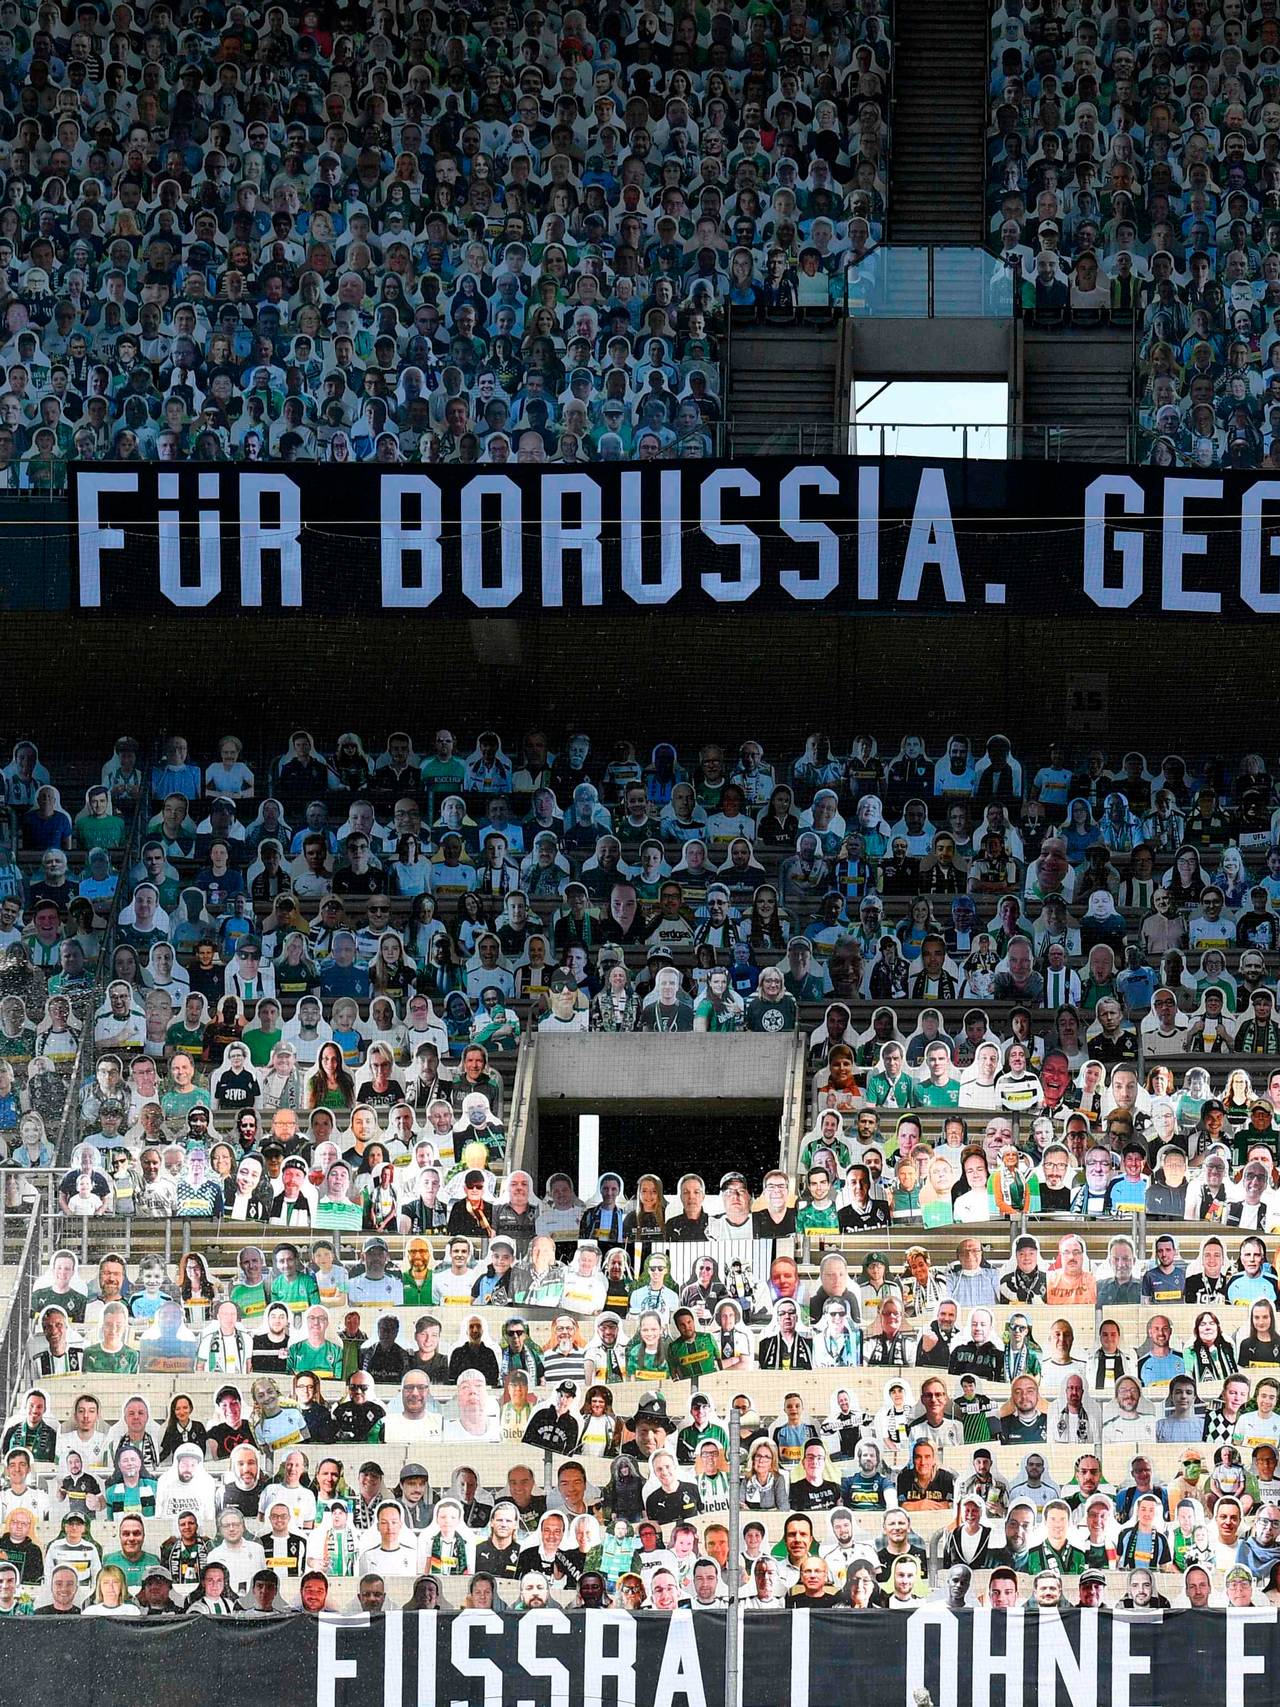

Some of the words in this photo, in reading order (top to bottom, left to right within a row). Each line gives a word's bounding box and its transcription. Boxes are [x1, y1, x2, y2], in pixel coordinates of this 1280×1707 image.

[380, 466, 1006, 609] BORUSSIA.
[224, 1088, 248, 1102] JEVER
[317, 1608, 810, 1707] FUSSBAL
[906, 1606, 1164, 1707] OHNE
